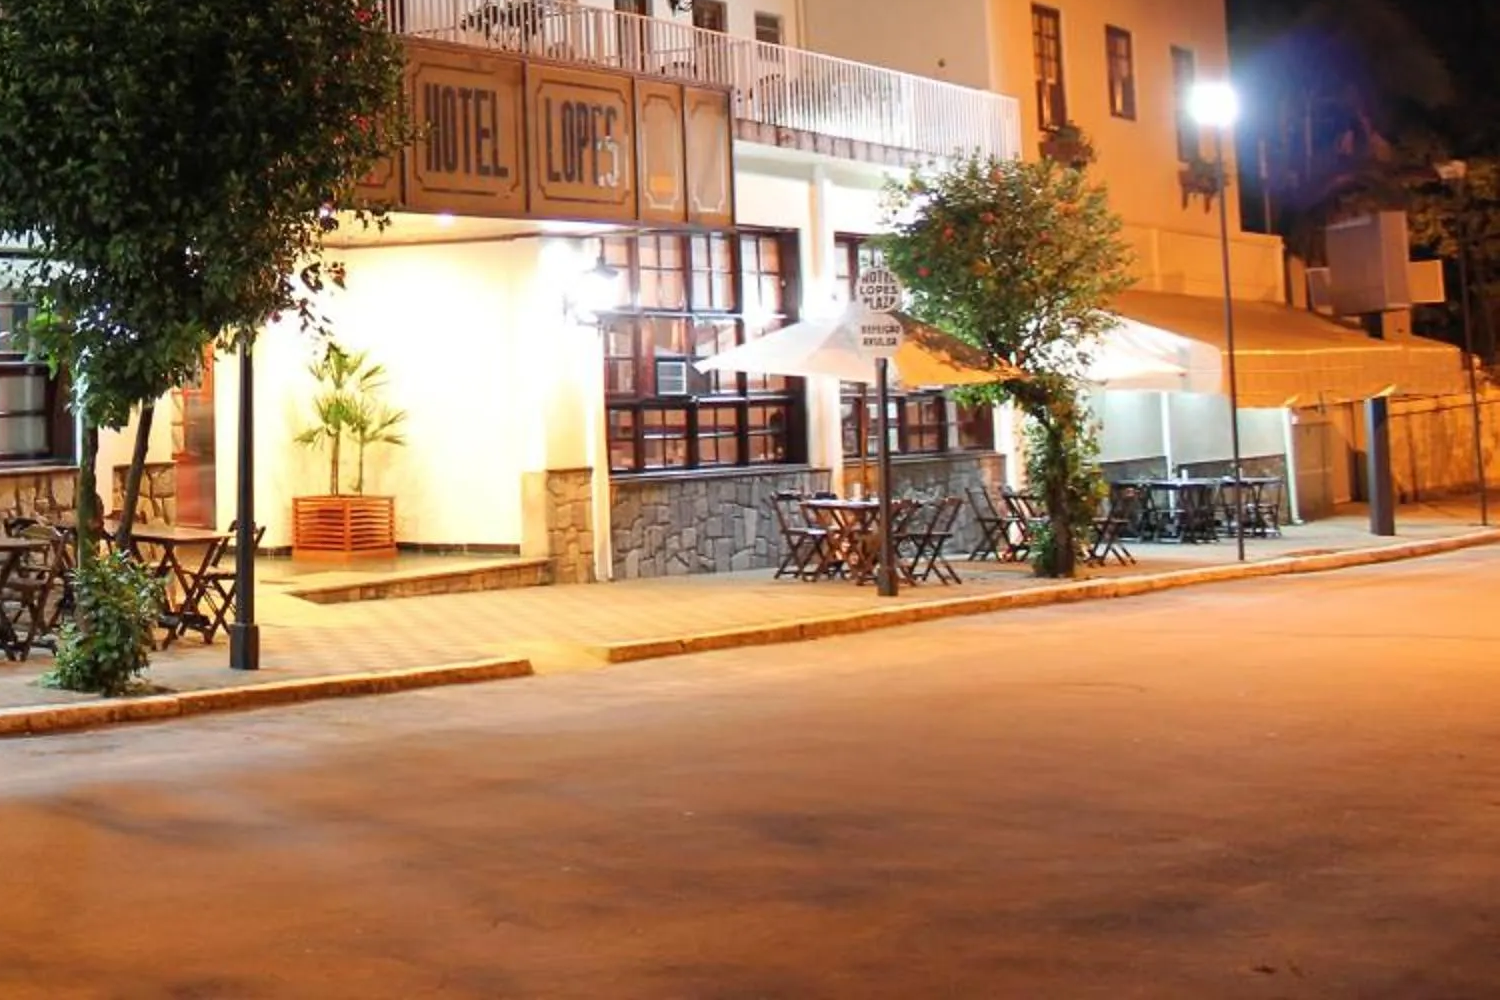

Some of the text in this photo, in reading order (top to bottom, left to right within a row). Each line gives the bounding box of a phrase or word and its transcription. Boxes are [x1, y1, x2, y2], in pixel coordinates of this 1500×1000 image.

[424, 82, 621, 188] HOTEL LOPES
[862, 270, 896, 284] HOTEL
[860, 285, 899, 295] LOPES
